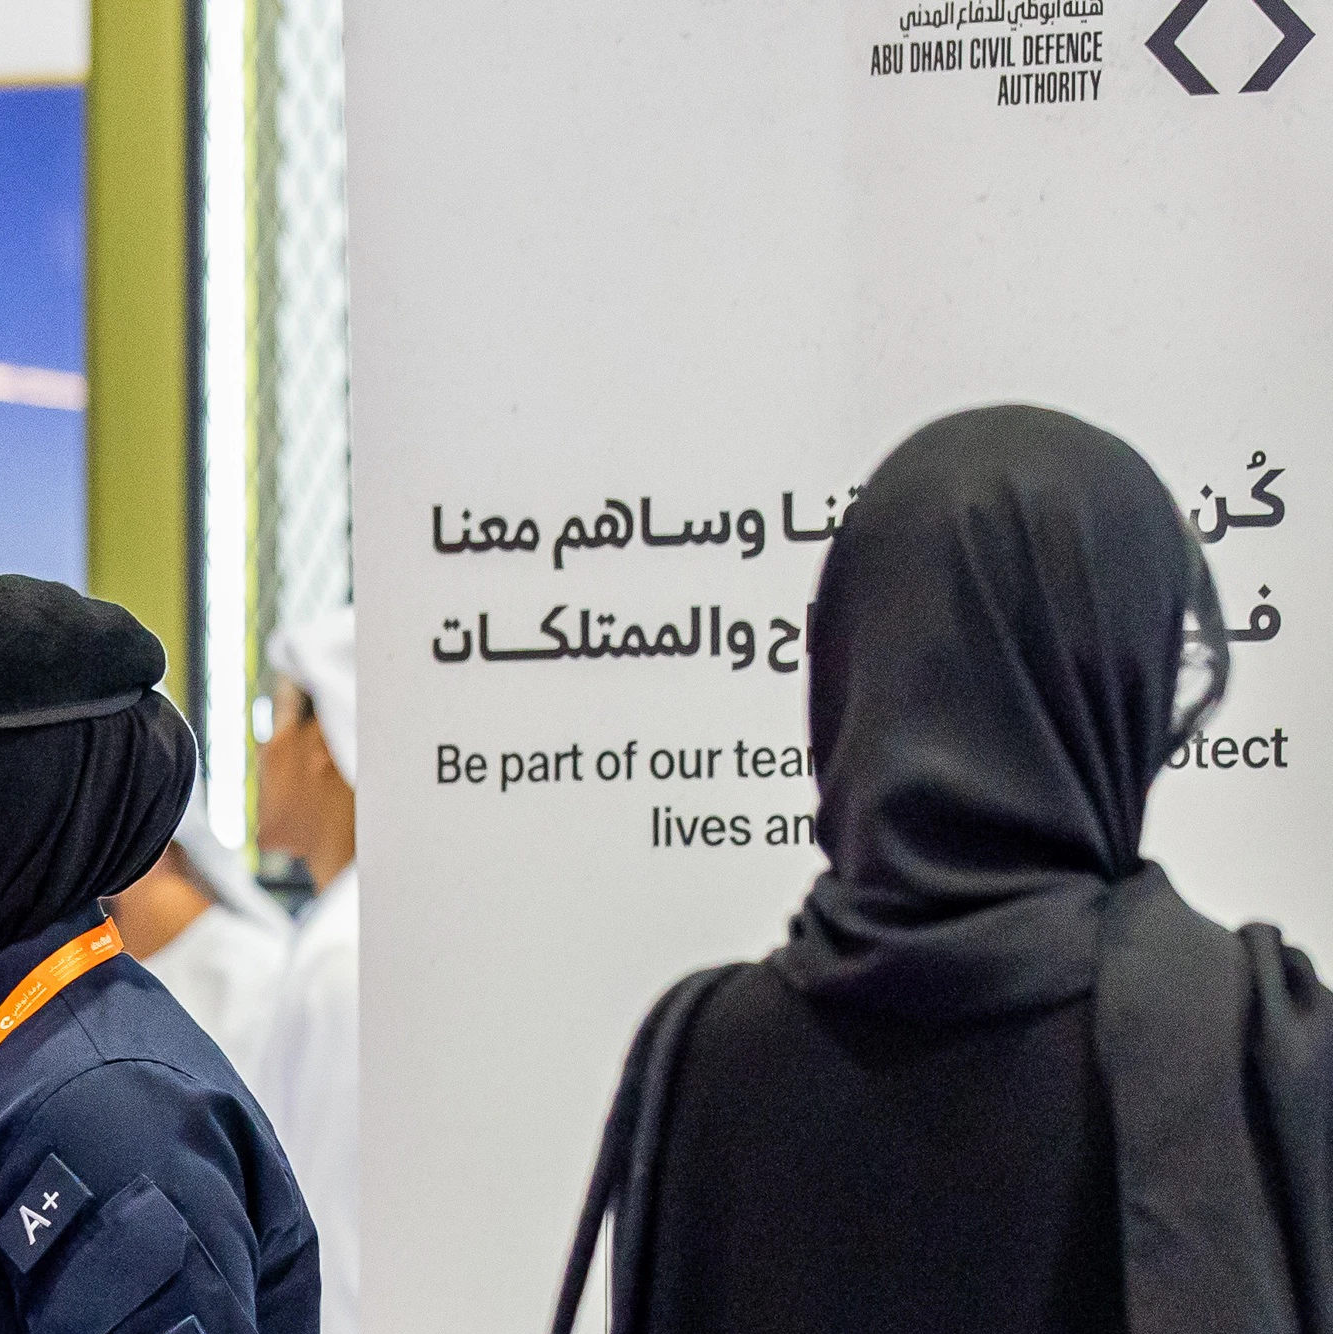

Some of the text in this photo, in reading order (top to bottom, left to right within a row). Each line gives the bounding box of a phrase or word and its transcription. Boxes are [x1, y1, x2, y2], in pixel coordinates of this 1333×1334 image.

[899, 2, 954, 38] المدني
[870, 31, 1103, 76] ABU DHABI CIVIL DEFENCE
[997, 69, 1103, 106] AUTHORITY
[432, 503, 541, 554] معنا
[553, 496, 767, 570] وساهم
[432, 604, 756, 673] والممتلكات
[436, 728, 1289, 793] Be part of our tea otect
[652, 806, 816, 848] lives an
